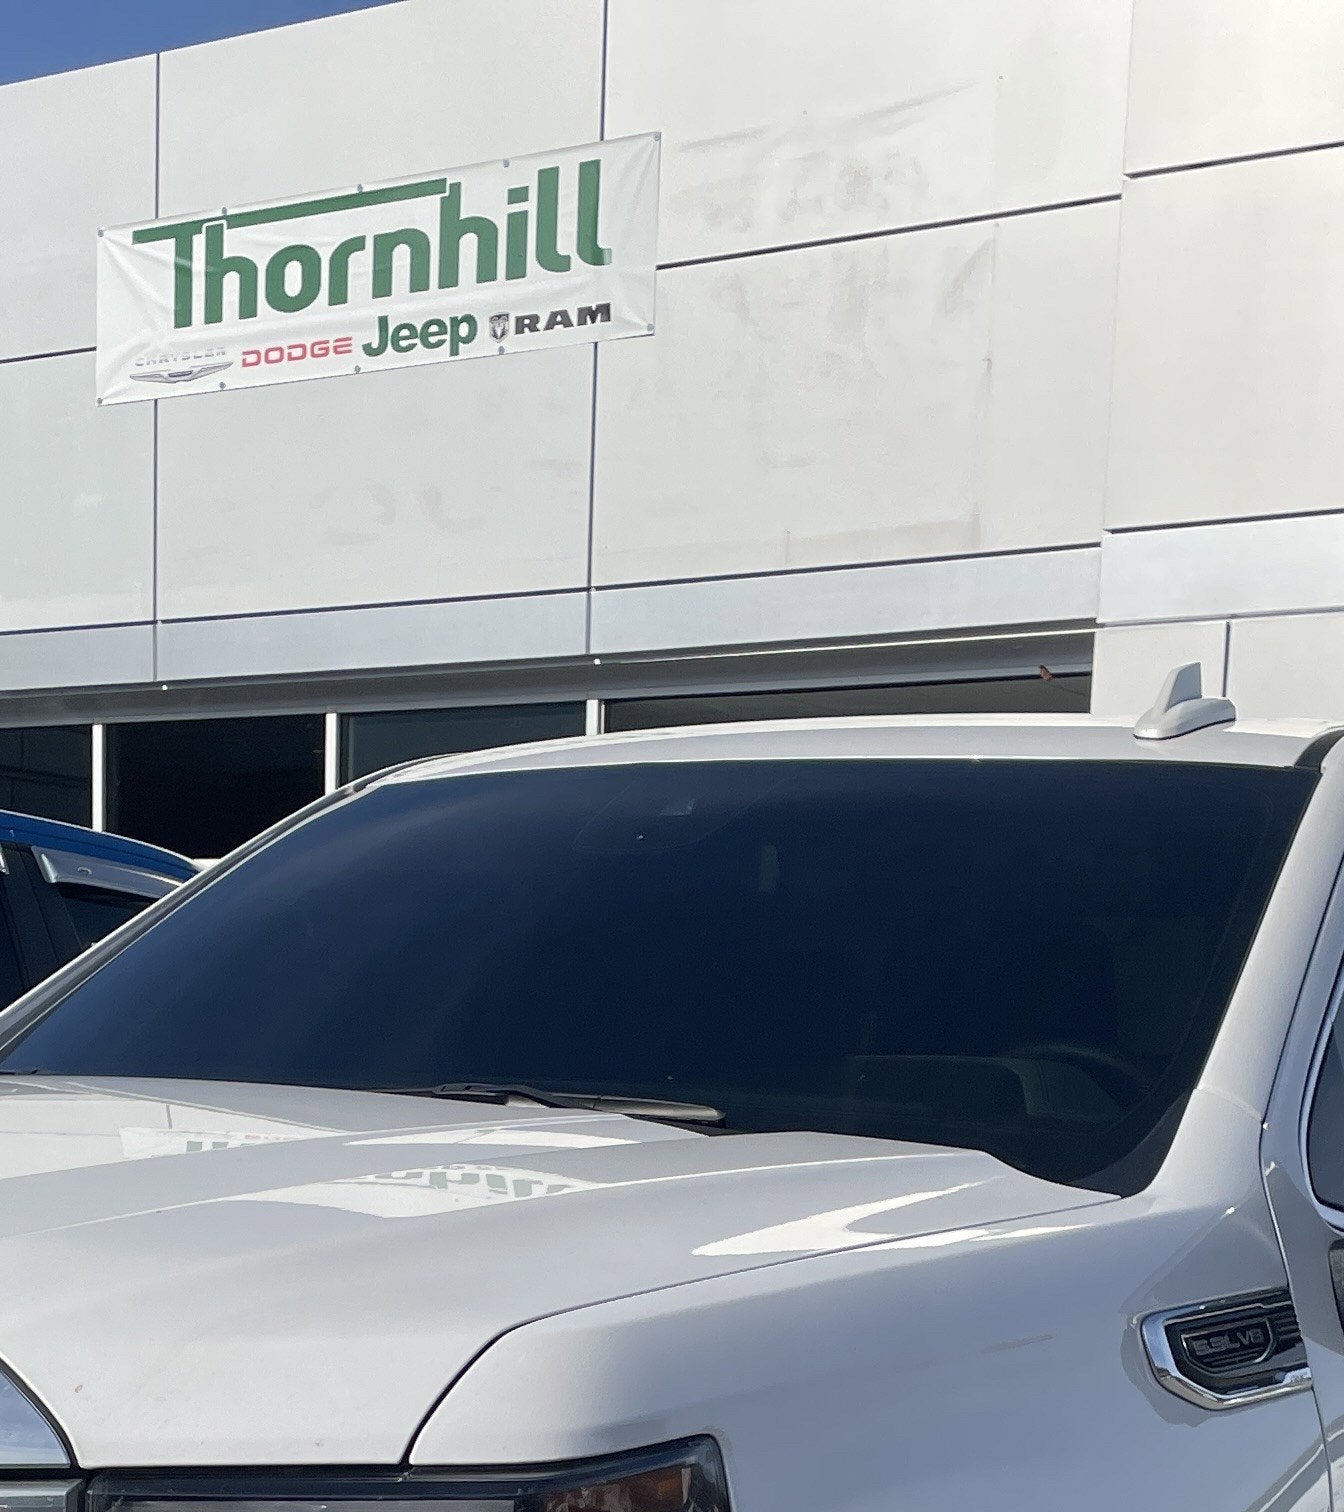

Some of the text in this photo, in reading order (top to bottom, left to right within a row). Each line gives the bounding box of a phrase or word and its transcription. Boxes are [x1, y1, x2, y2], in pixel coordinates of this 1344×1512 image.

[132, 159, 612, 328] Thornhill
[241, 337, 353, 368] DODGE
[362, 313, 478, 356] Jeep
[514, 303, 612, 336] RAM
